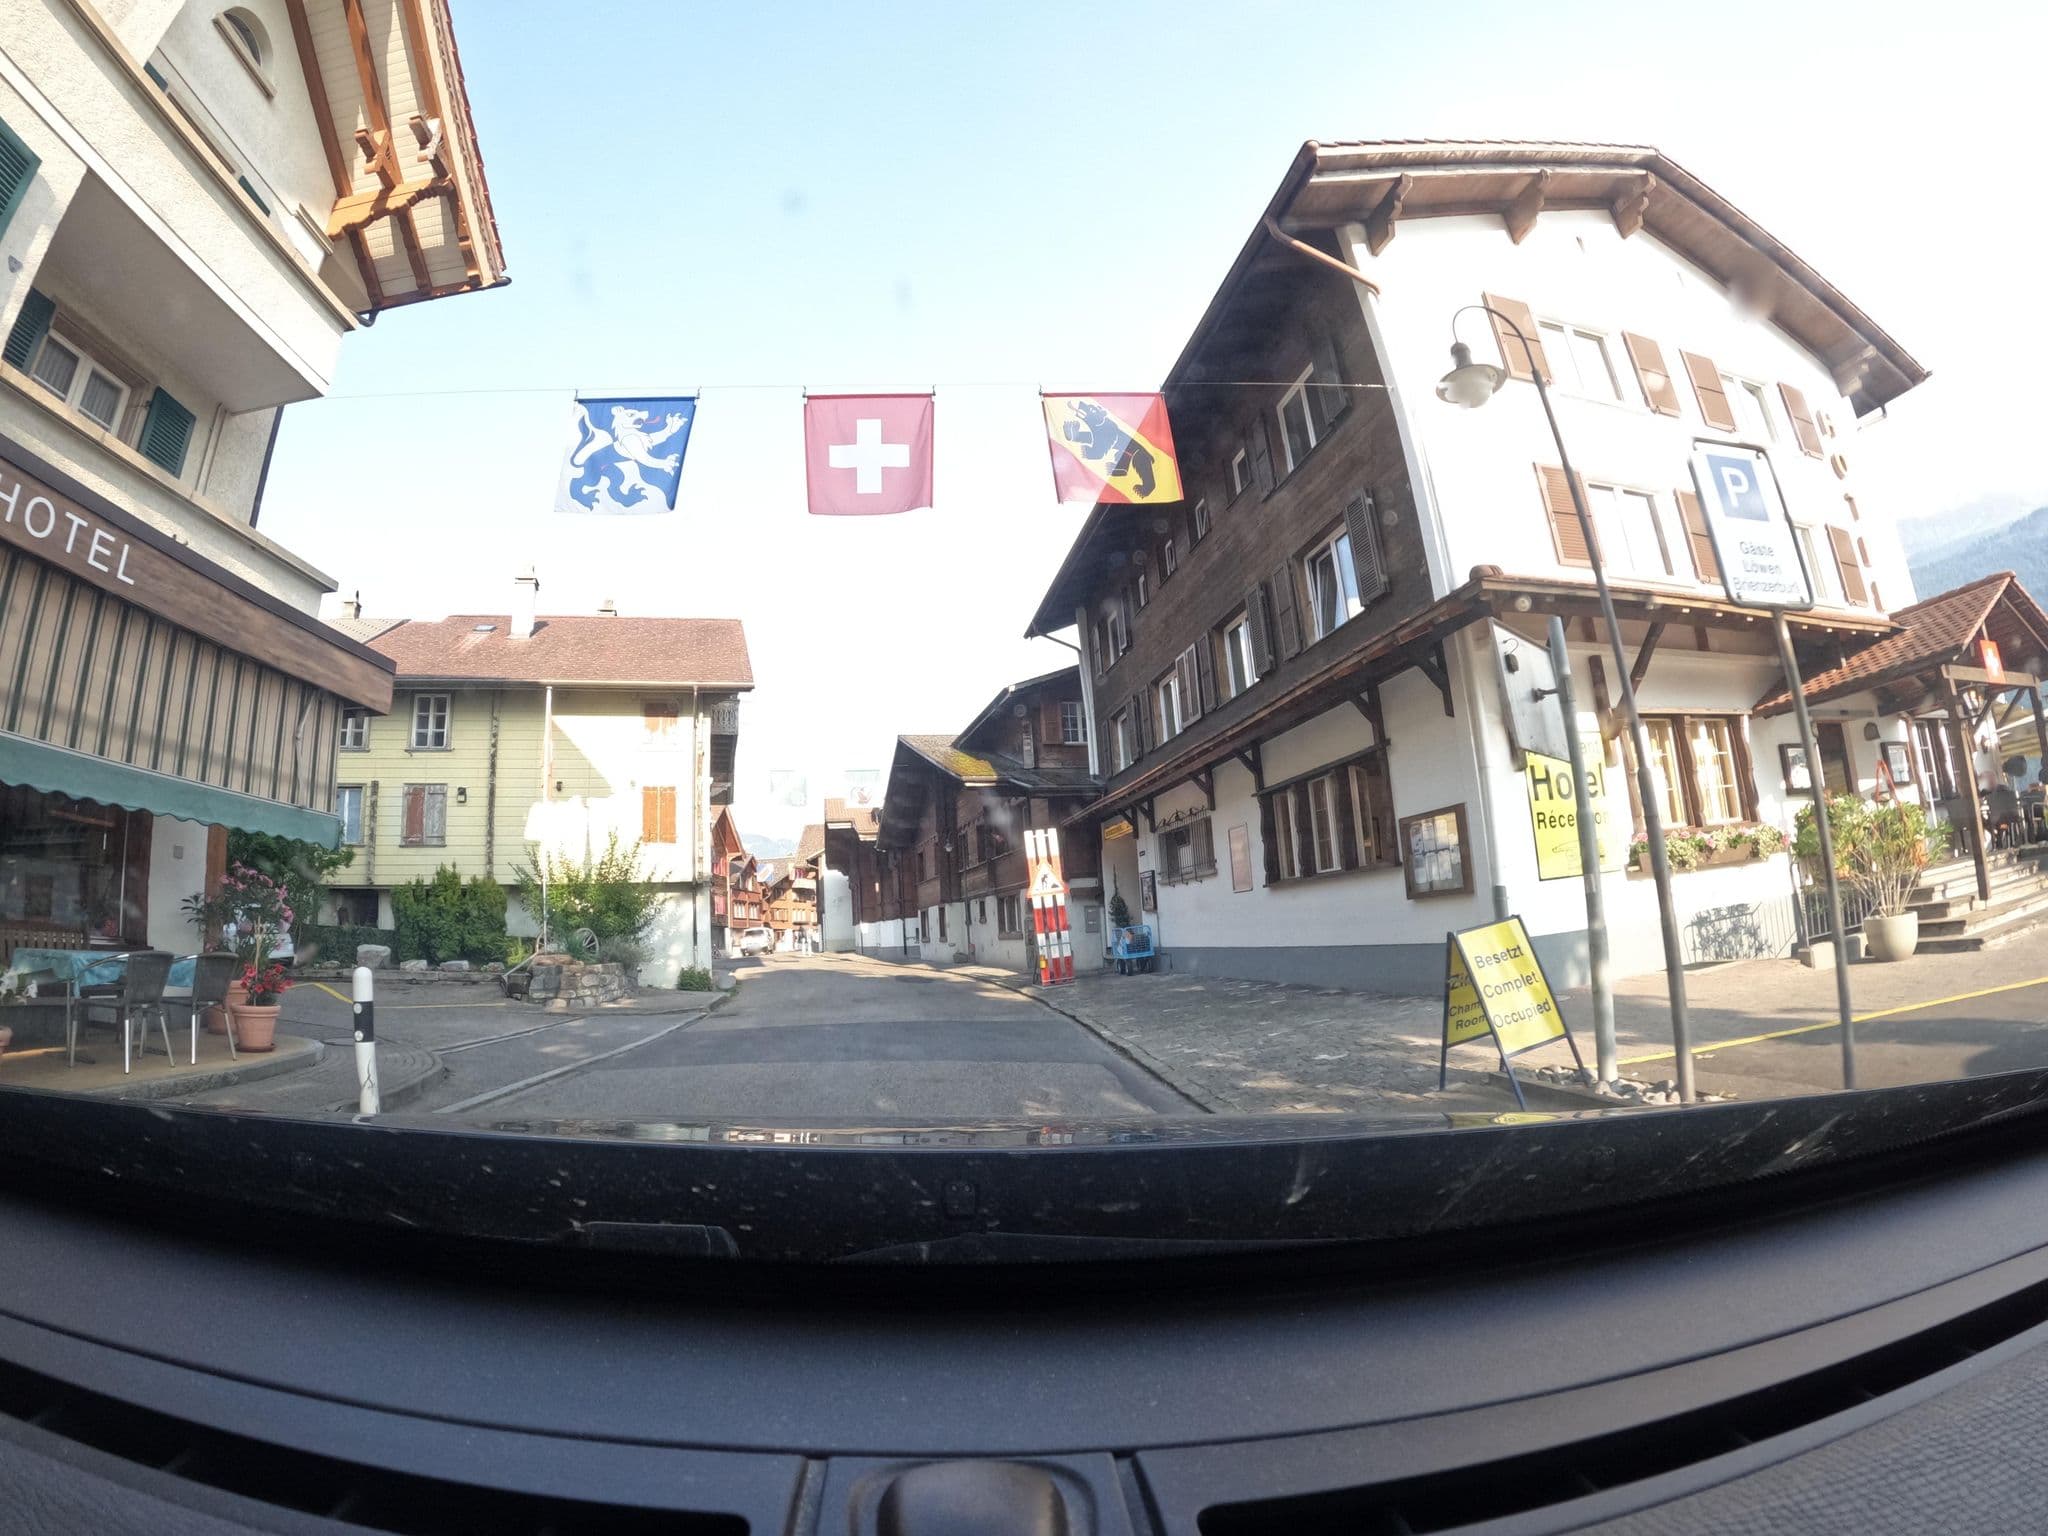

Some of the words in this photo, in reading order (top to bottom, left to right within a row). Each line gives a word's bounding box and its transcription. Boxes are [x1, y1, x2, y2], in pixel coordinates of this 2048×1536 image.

[1720, 466, 1750, 508] P
[0, 472, 136, 586] HOTEL
[1530, 762, 1606, 802] Hoel
[1474, 944, 1524, 969] Besetzt
[1483, 971, 1539, 999] Complet
[1492, 998, 1552, 1028] Occupied
